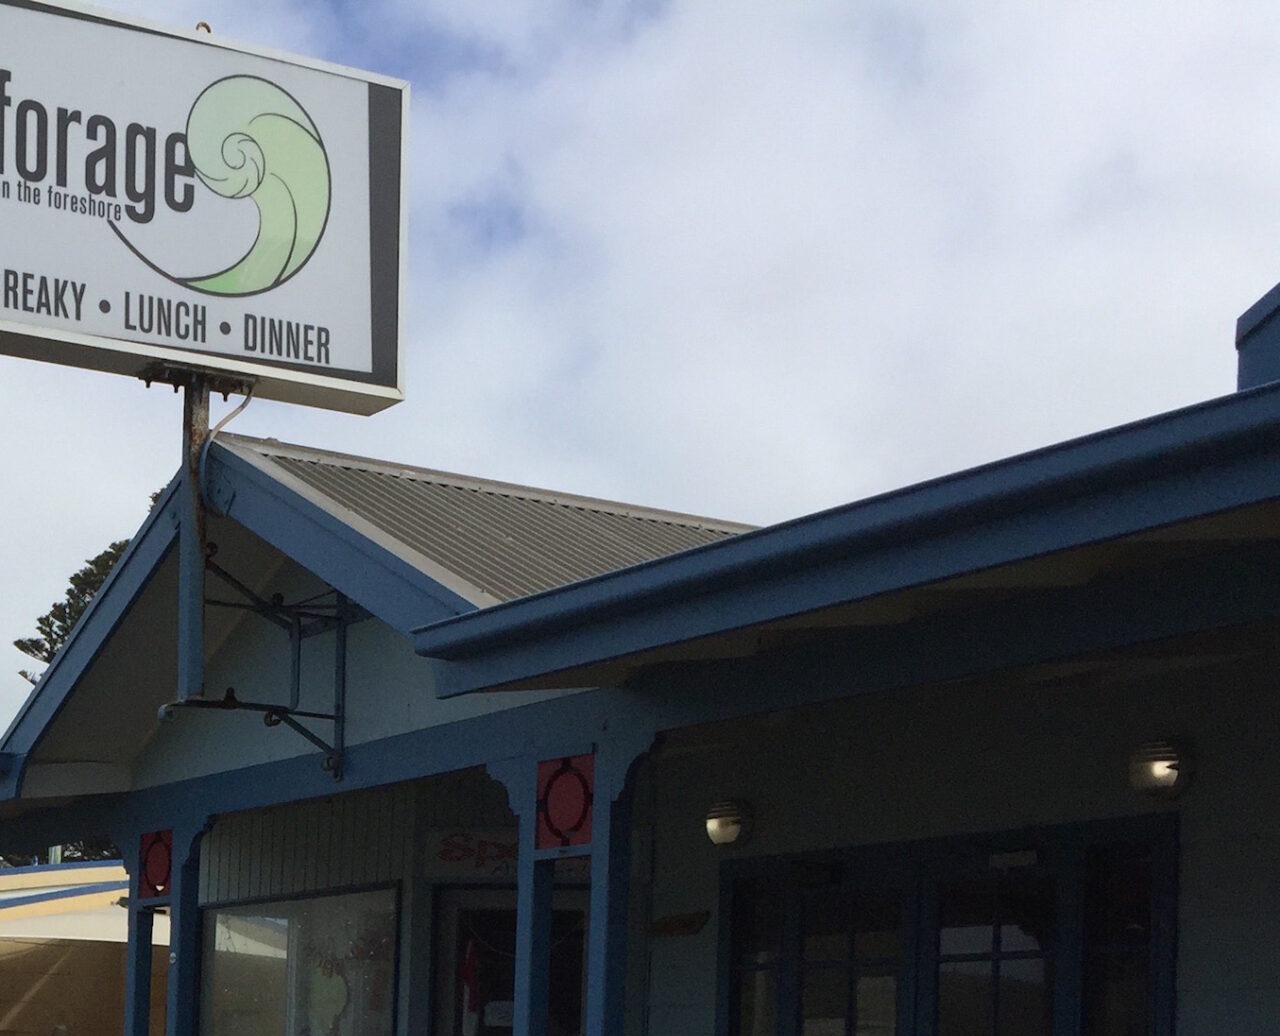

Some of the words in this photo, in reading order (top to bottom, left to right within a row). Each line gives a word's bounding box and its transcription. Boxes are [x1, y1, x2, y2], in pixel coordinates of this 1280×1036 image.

[17, 180, 41, 206] the
[47, 186, 122, 222] foreshore
[125, 291, 207, 343] LUNCH
[244, 314, 330, 364] DINNER
